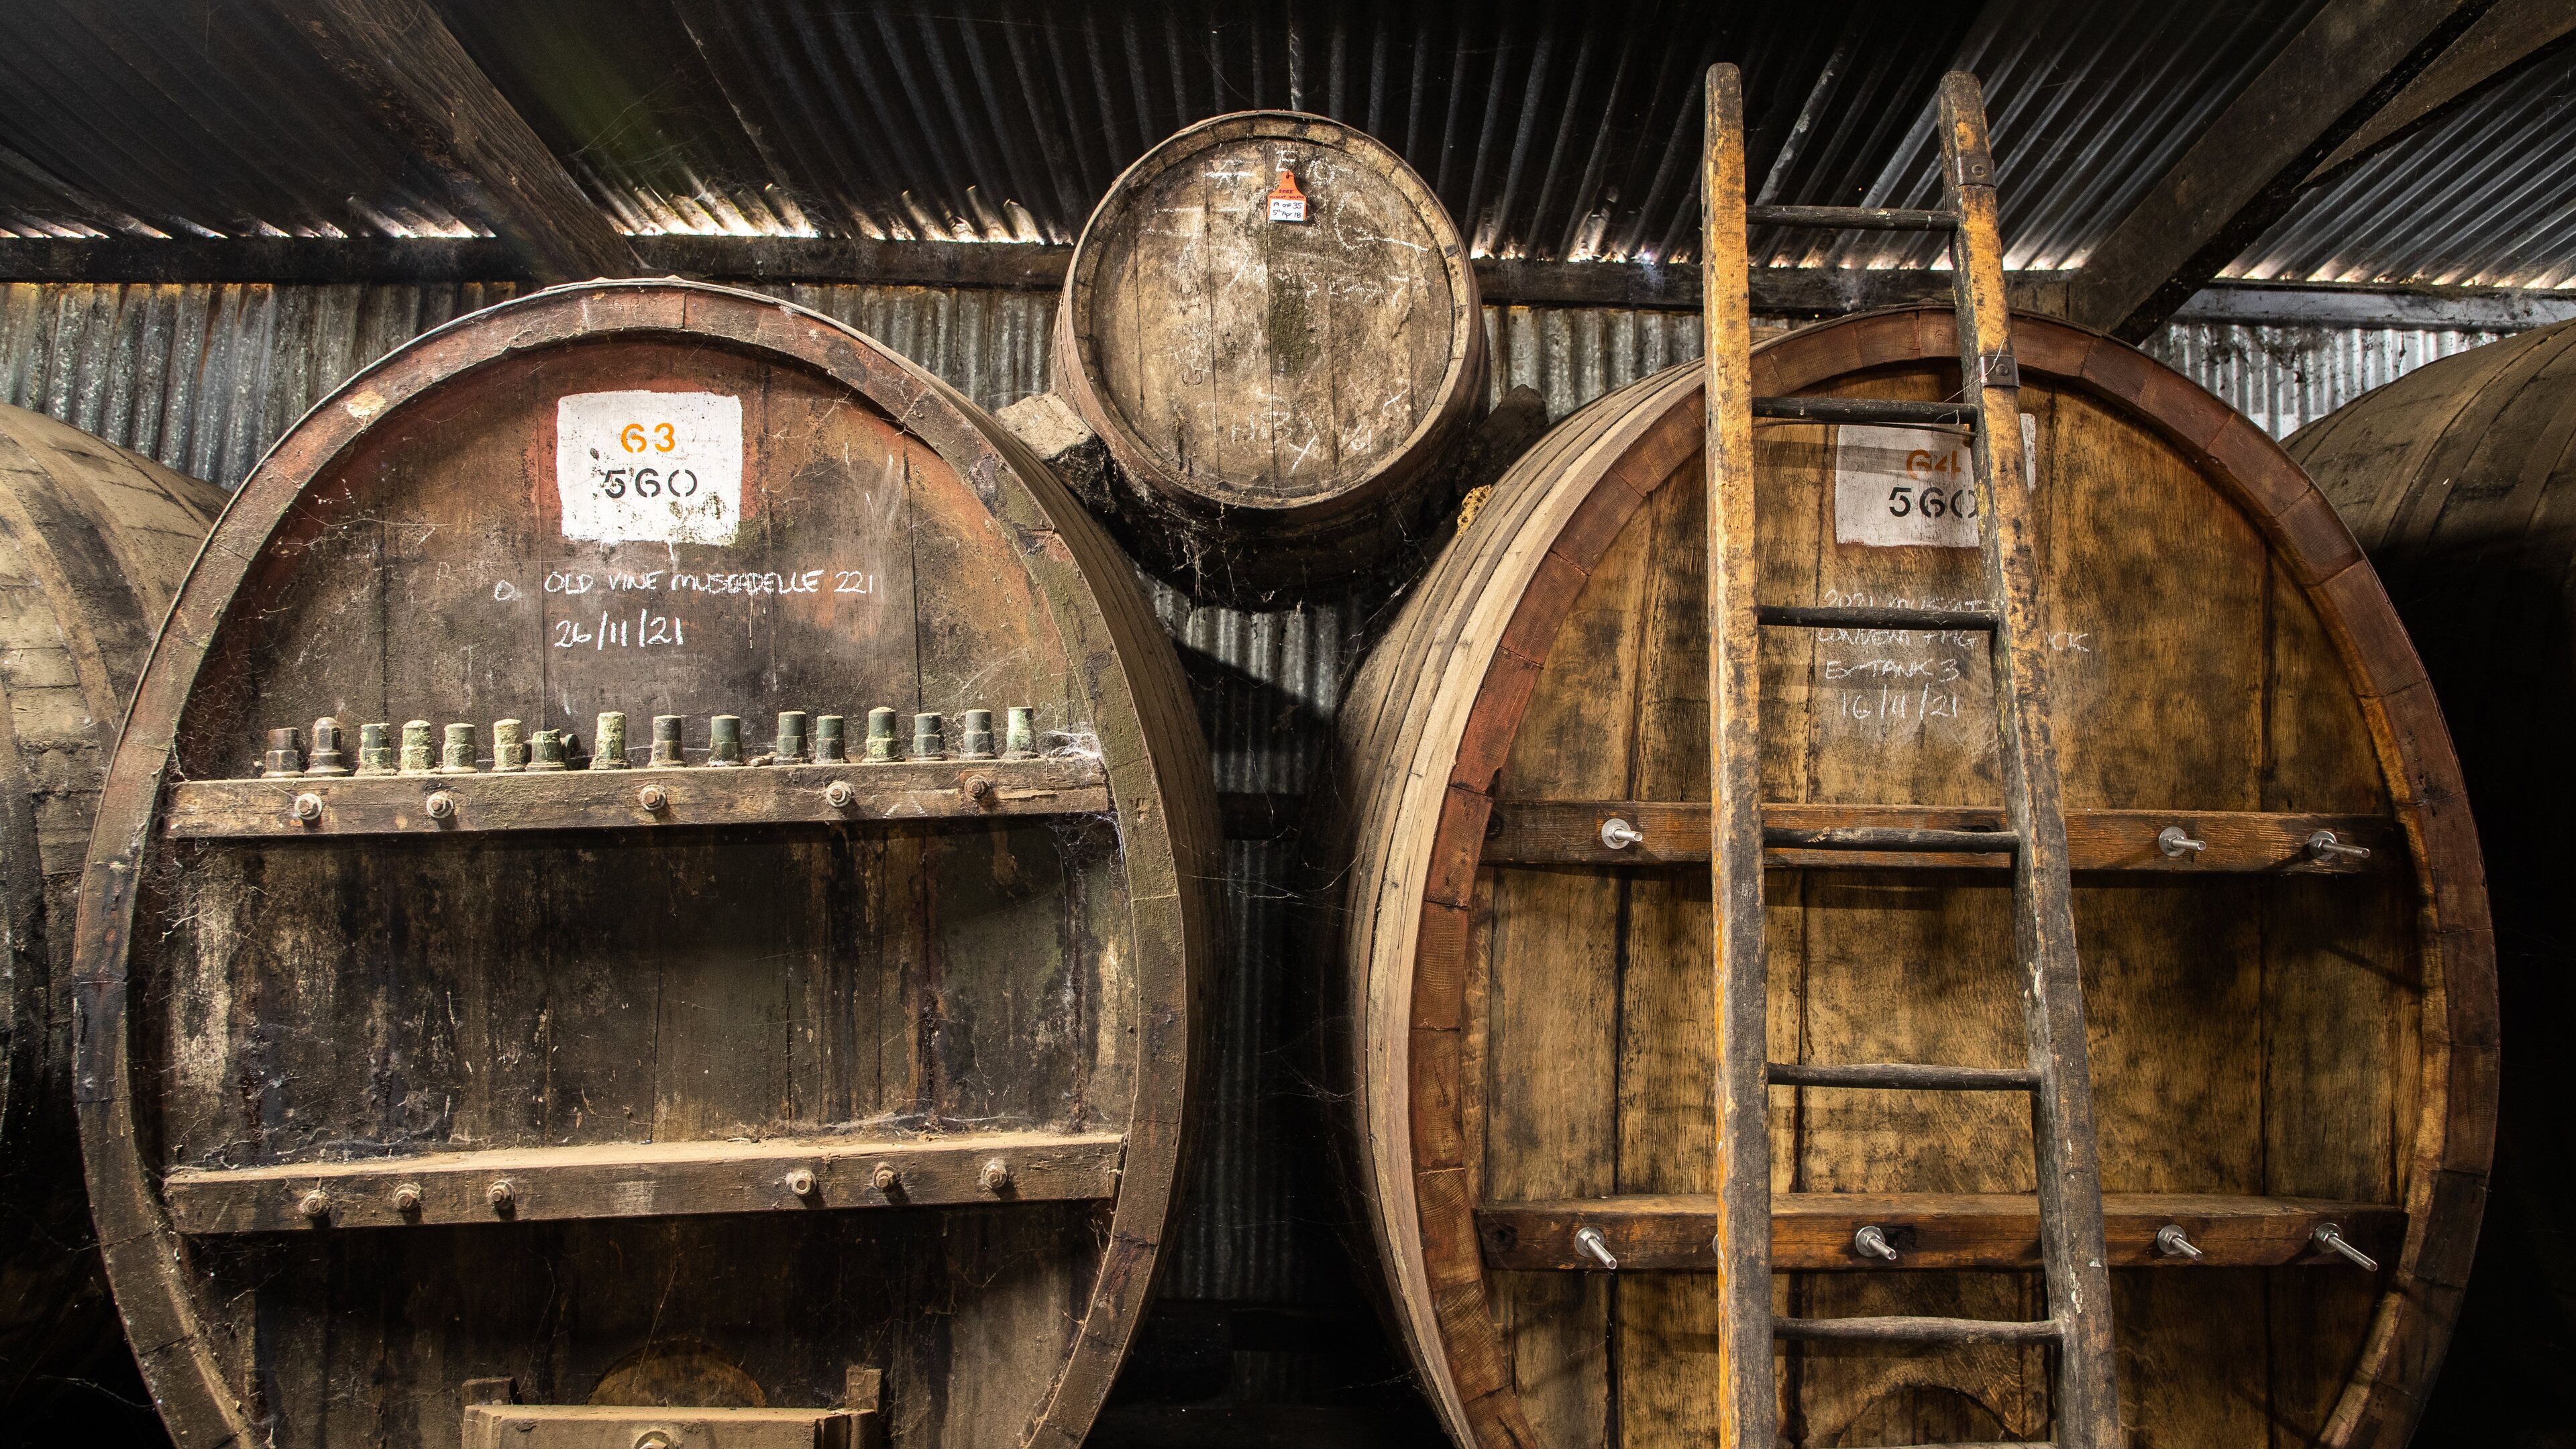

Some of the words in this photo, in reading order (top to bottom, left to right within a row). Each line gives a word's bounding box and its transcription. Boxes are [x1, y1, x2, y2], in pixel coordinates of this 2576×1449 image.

[1281, 211, 1293, 219] Apr
[621, 423, 676, 453] 63
[1907, 449, 1962, 480] 64
[604, 468, 698, 499] 560
[1888, 486, 1978, 519] 560
[545, 571, 594, 595] OLD
[608, 570, 664, 592] VINE
[834, 570, 873, 594] 221
[554, 608, 684, 650] 26/11/21
[1939, 658, 1960, 683] 3
[1843, 682, 1960, 720] 16/11/21
